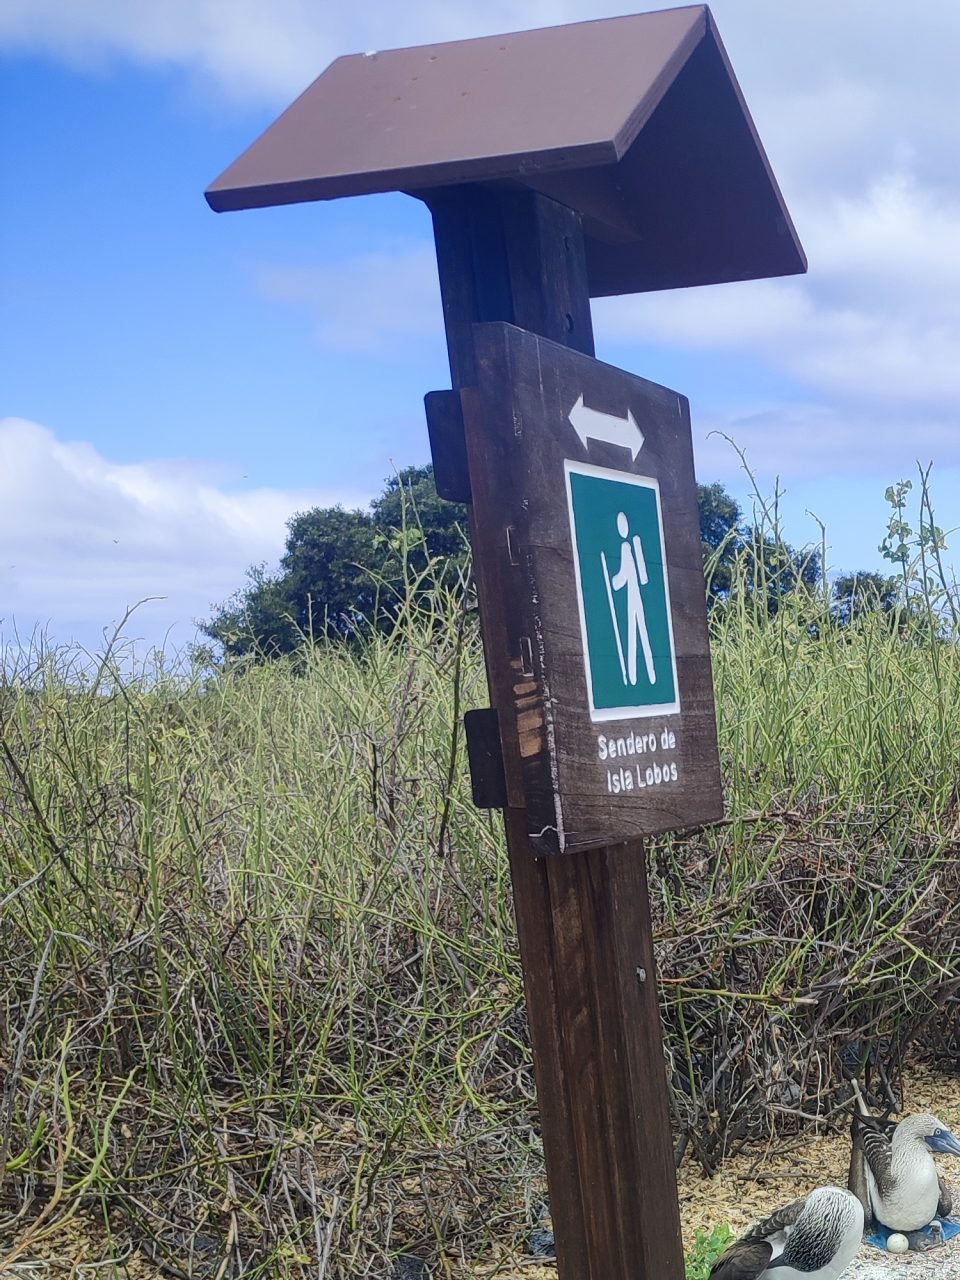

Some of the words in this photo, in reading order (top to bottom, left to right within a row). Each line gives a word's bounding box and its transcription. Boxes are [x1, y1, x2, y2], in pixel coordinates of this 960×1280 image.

[598, 730, 657, 760] Sendero
[660, 726, 676, 750] de
[607, 767, 634, 794] Isla
[636, 761, 678, 788] Lobos
